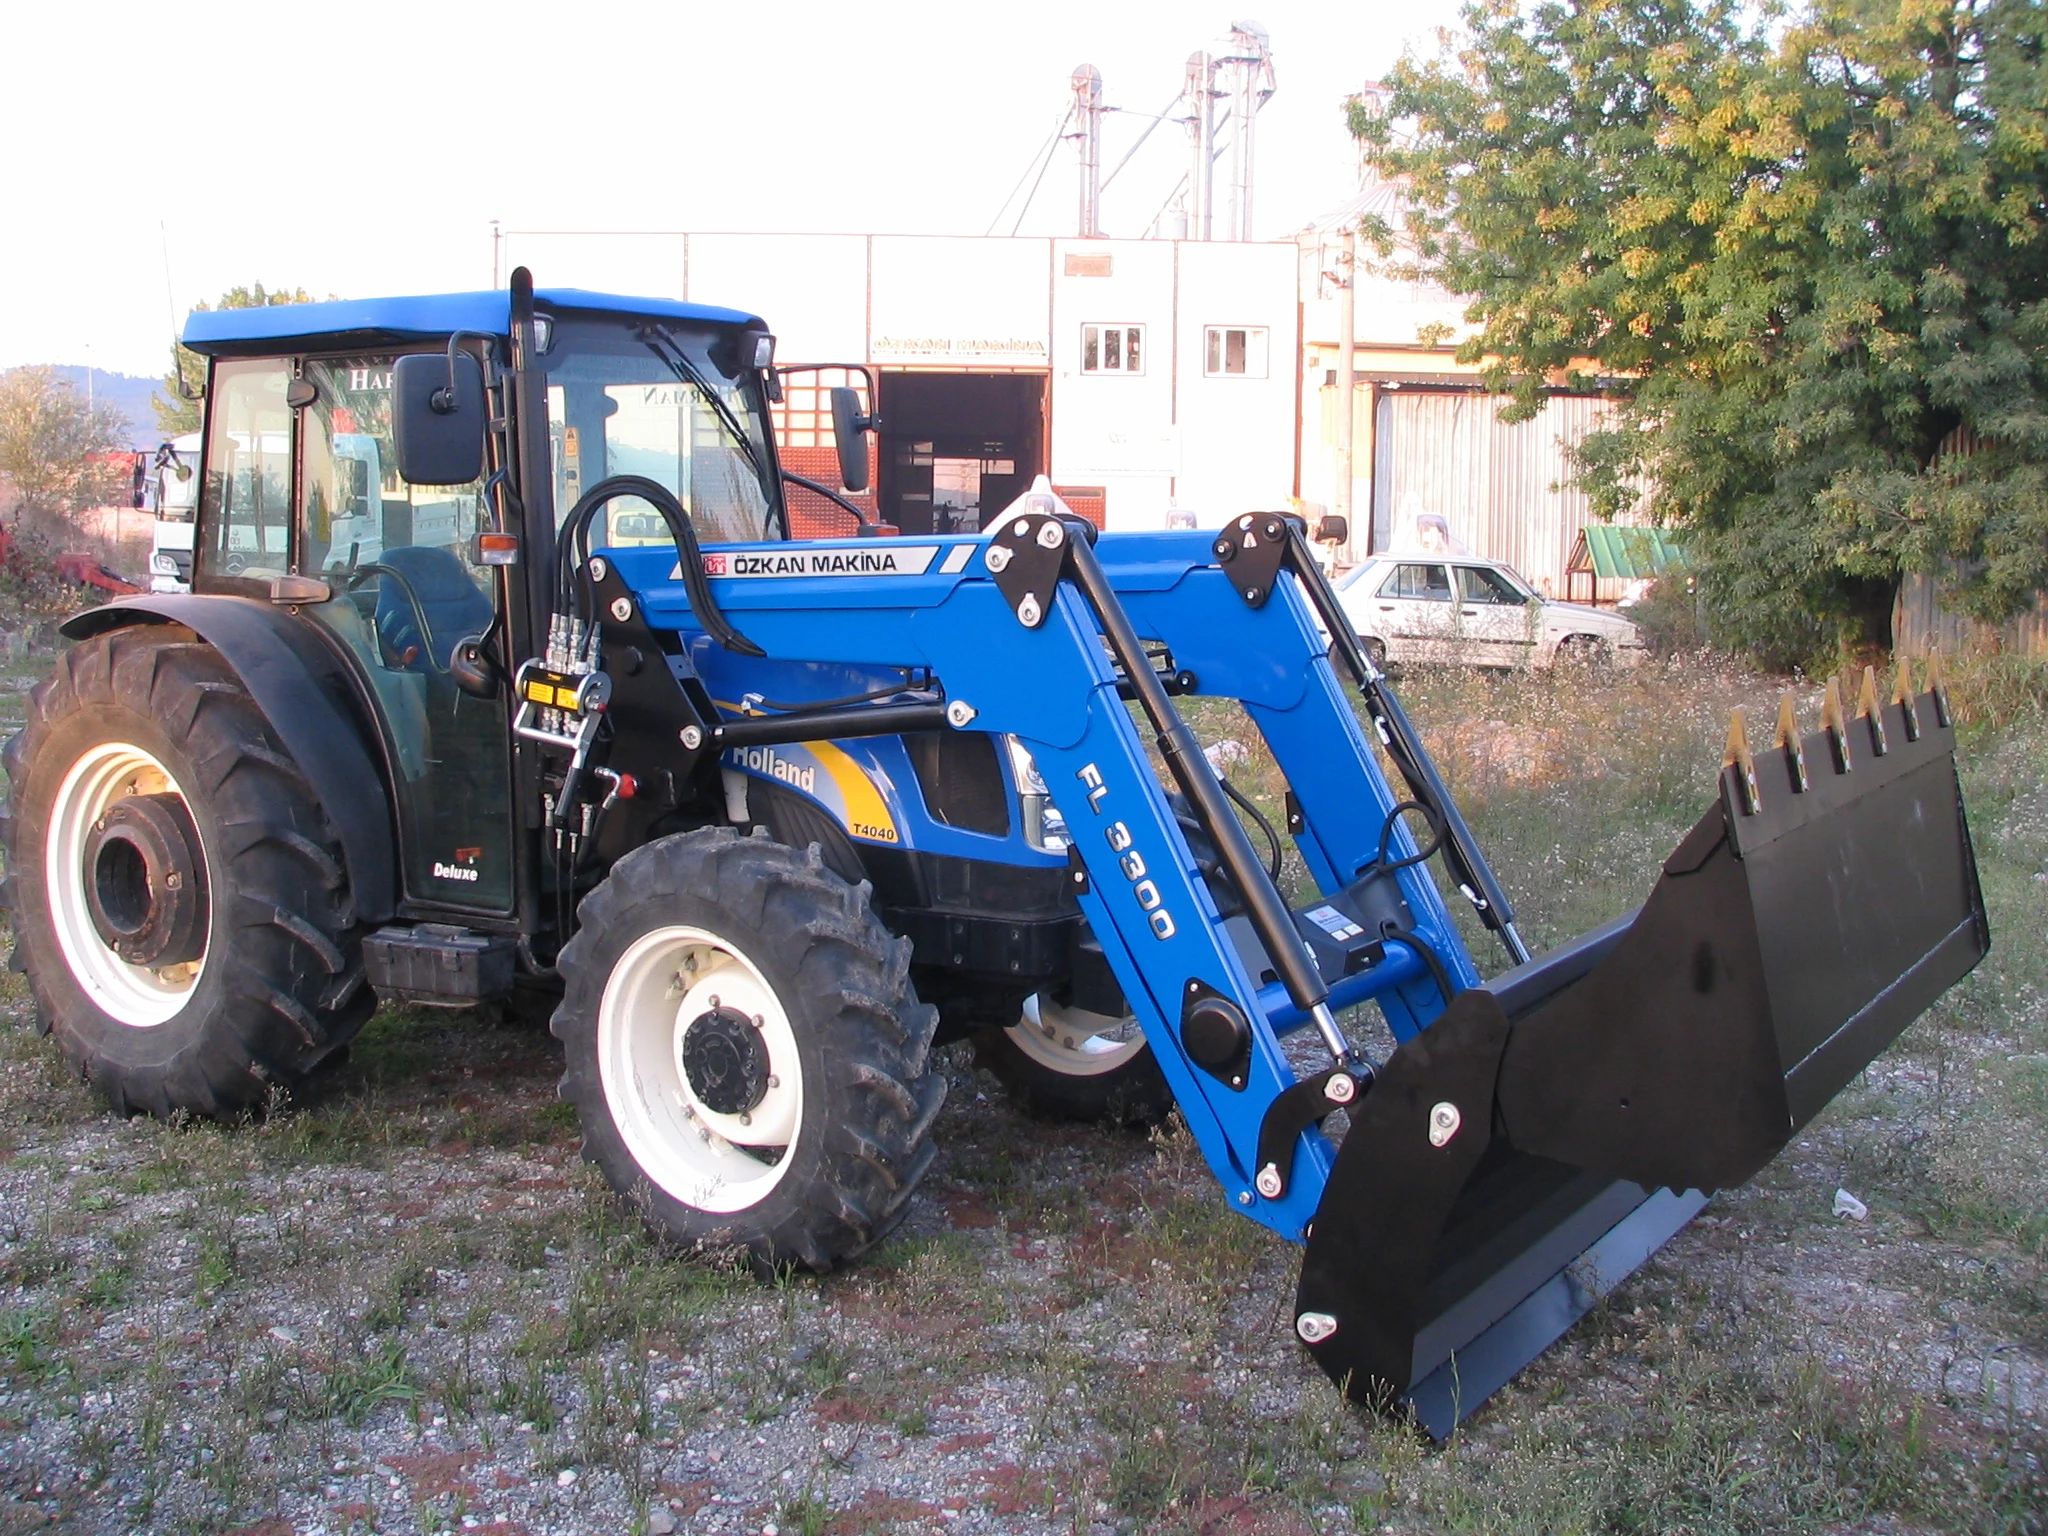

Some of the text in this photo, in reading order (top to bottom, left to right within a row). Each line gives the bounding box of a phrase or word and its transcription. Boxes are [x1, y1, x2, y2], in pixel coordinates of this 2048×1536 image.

[734, 554, 805, 574] ÖZKAN
[812, 551, 898, 573] MAKİNA
[732, 746, 815, 794] Holland
[853, 822, 895, 840] T4040
[1075, 762, 1176, 941] FL 3300
[433, 862, 478, 882] Deluxe
